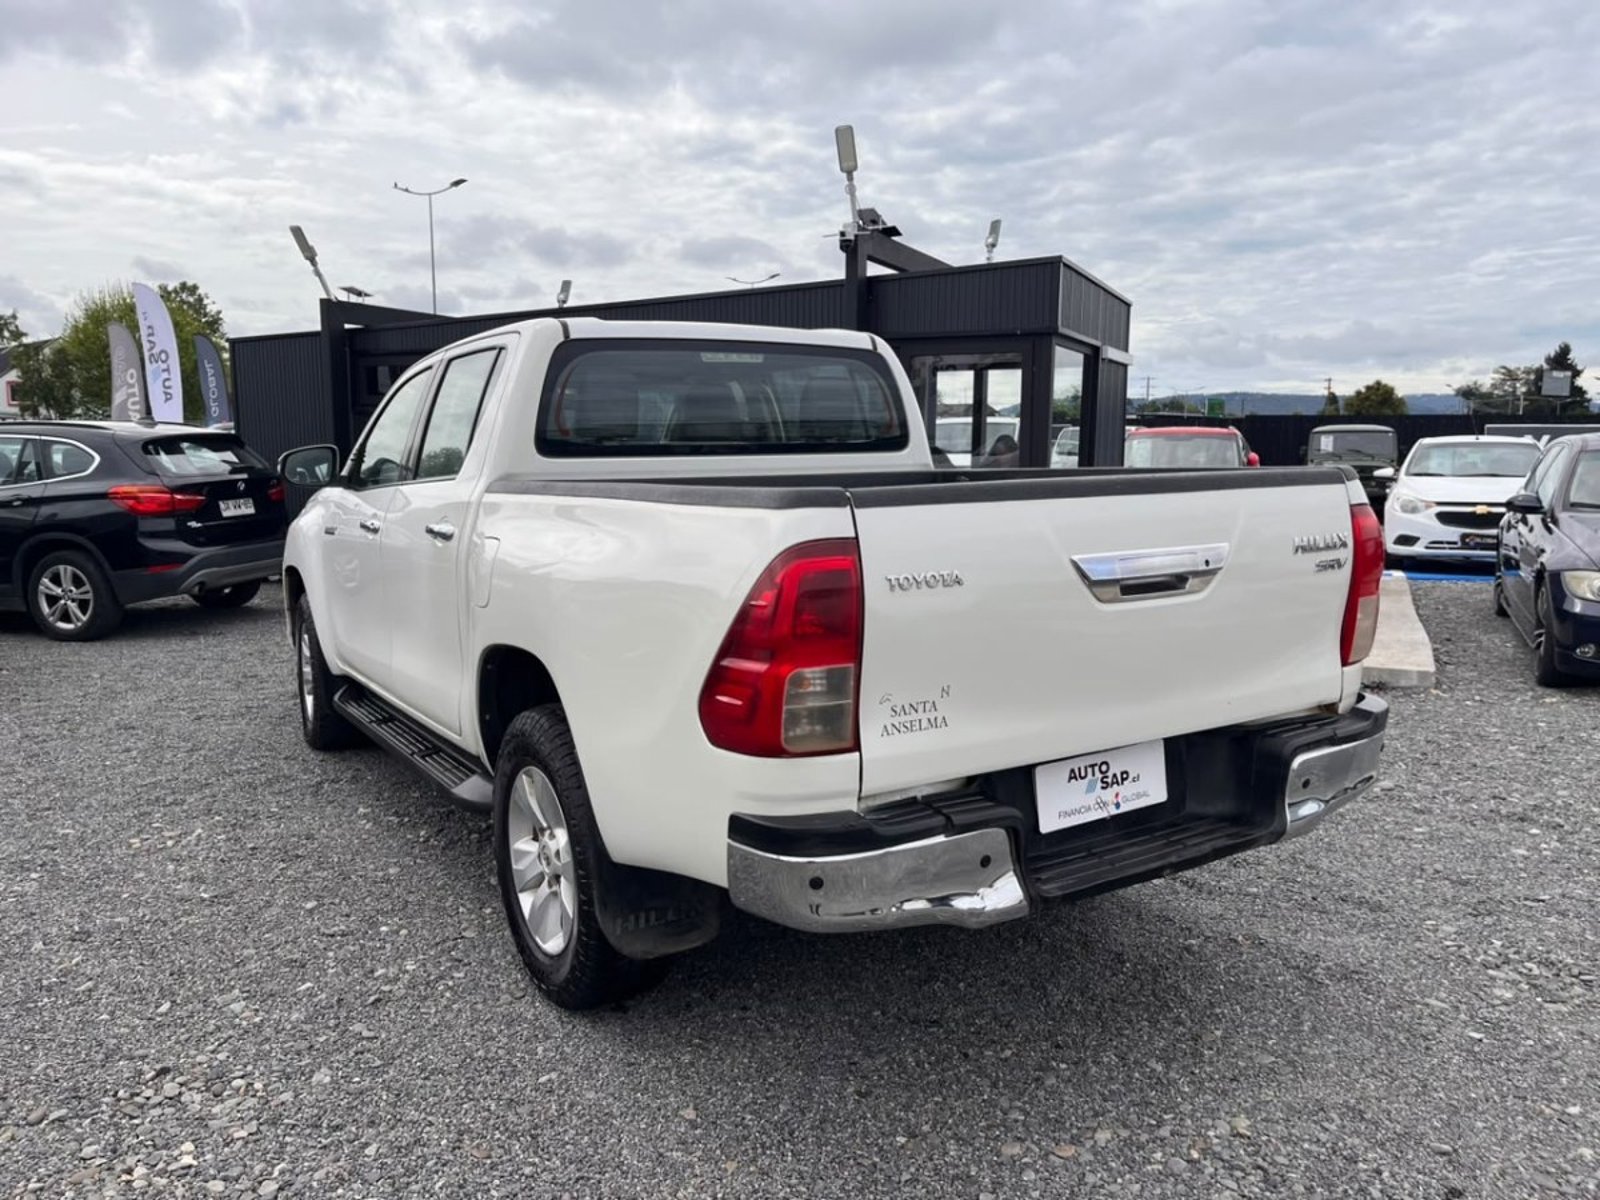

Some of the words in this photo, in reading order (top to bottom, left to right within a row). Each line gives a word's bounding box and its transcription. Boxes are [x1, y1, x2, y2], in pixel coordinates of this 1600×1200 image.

[1293, 533, 1348, 555] HILUX
[885, 569, 964, 593] TOYOTA
[890, 700, 938, 718] SANTA
[880, 716, 948, 737] ANSELMA
[1067, 760, 1110, 783] AUTO
[1058, 806, 1092, 819] FINANCIA
[1122, 790, 1150, 804] GLOBAL
